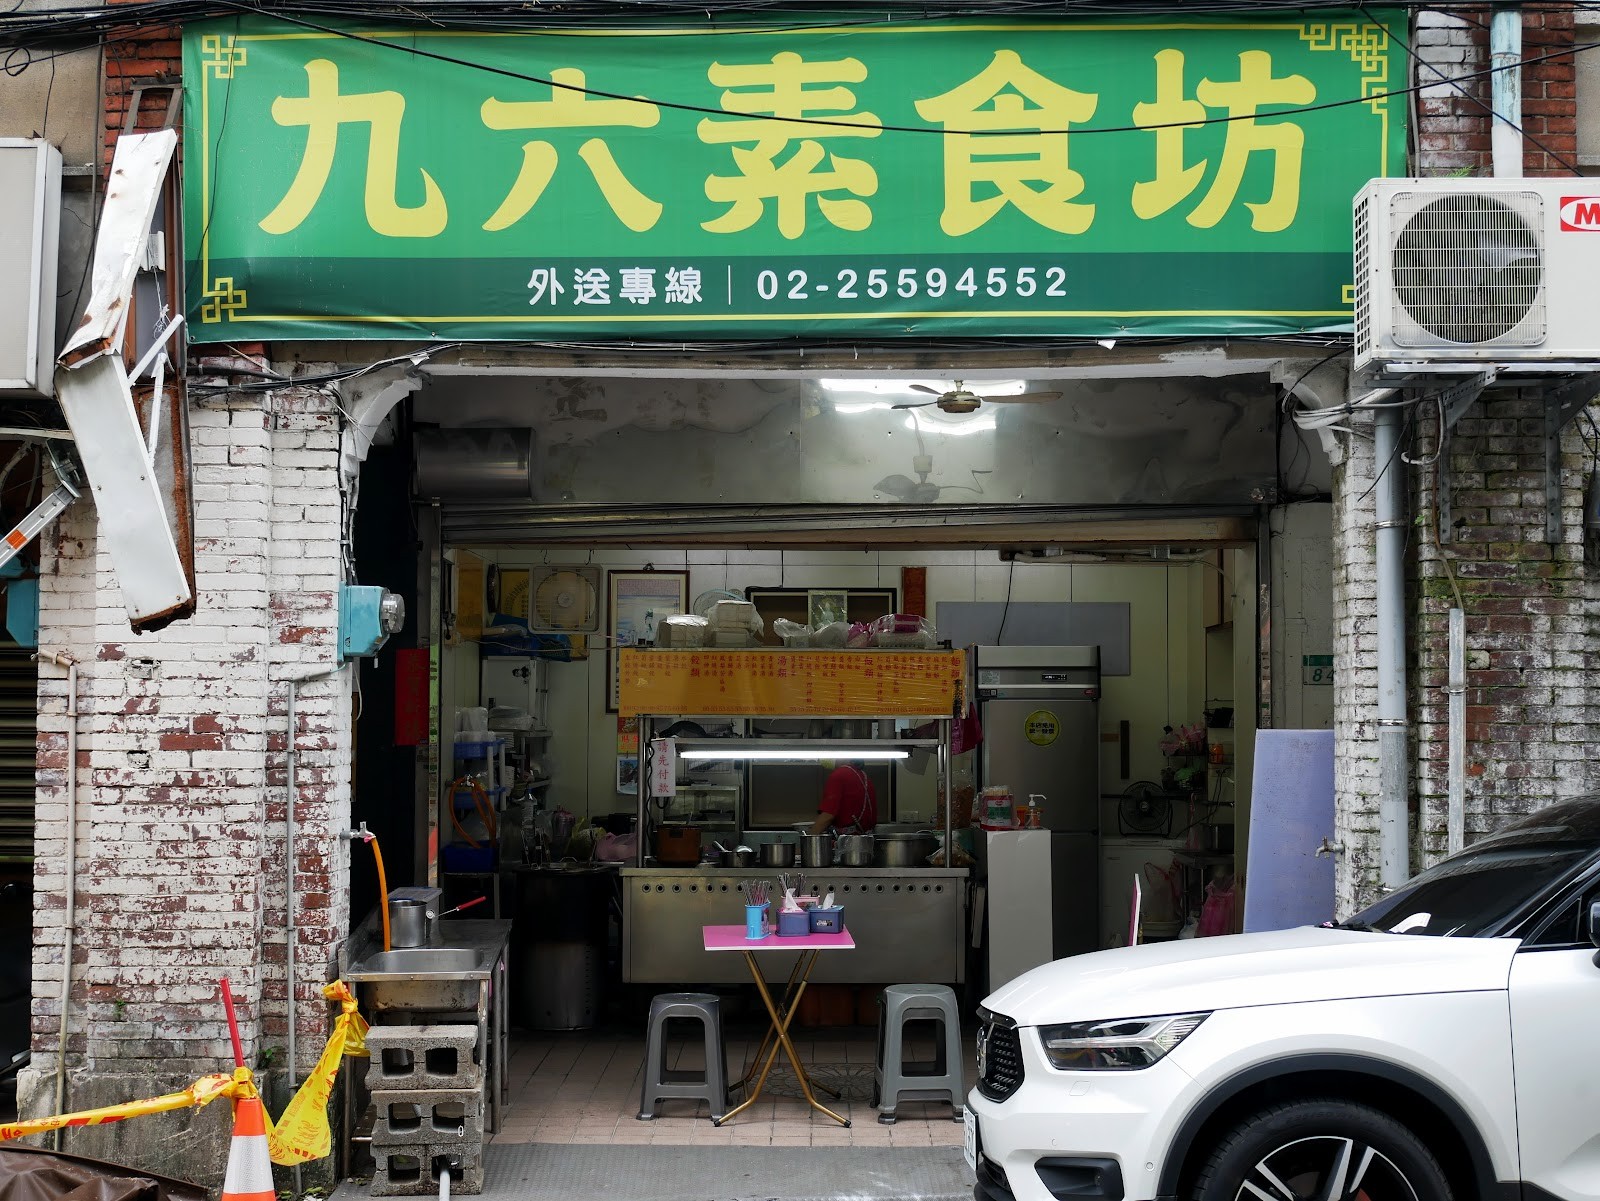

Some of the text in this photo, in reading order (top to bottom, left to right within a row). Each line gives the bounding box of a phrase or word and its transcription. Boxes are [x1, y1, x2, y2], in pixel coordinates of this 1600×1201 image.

[258, 49, 1318, 241] 九六素食坊
[527, 266, 1069, 307] 外送專線 02-25594552
[657, 741, 669, 793] 請先付款
